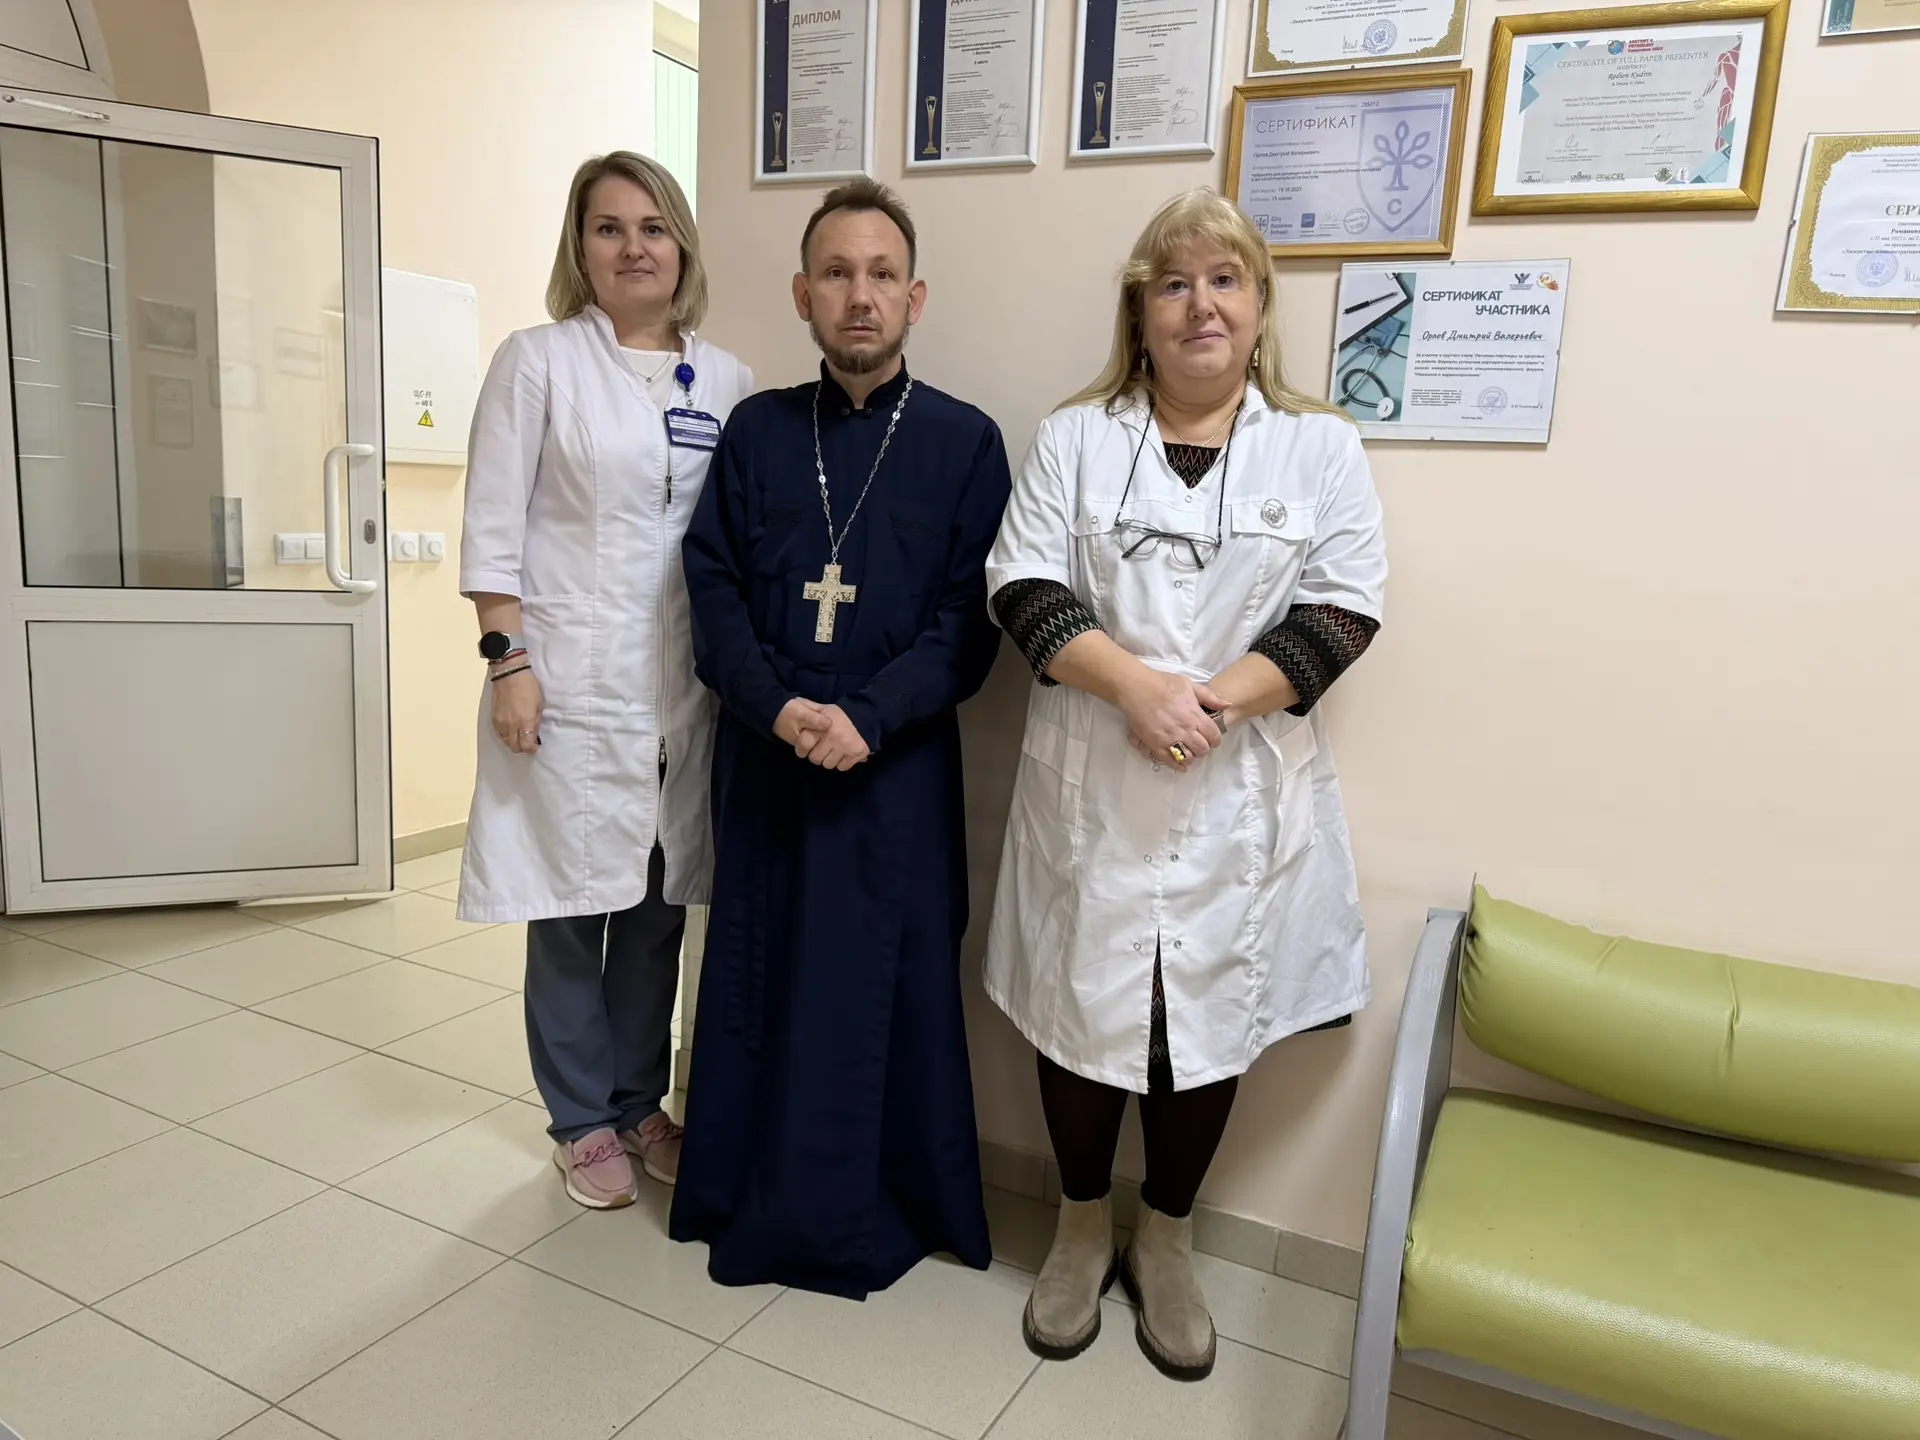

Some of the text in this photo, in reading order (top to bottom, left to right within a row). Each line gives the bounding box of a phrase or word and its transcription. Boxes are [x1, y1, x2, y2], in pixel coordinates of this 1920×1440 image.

[792, 10, 841, 28] ДИПЛОМ
[1557, 59, 1605, 68] CERTIFICATE
[1639, 55, 1663, 63] PAPER
[1664, 52, 1708, 61] PRESENTER
[1256, 115, 1356, 133] СЕРТИФИКАТ
[1422, 290, 1503, 302] СЕРТИФИКАТ
[1475, 304, 1550, 316] УЧАСТНИКА
[1422, 330, 1542, 342] Орлов Дмитрий Валерьевич
